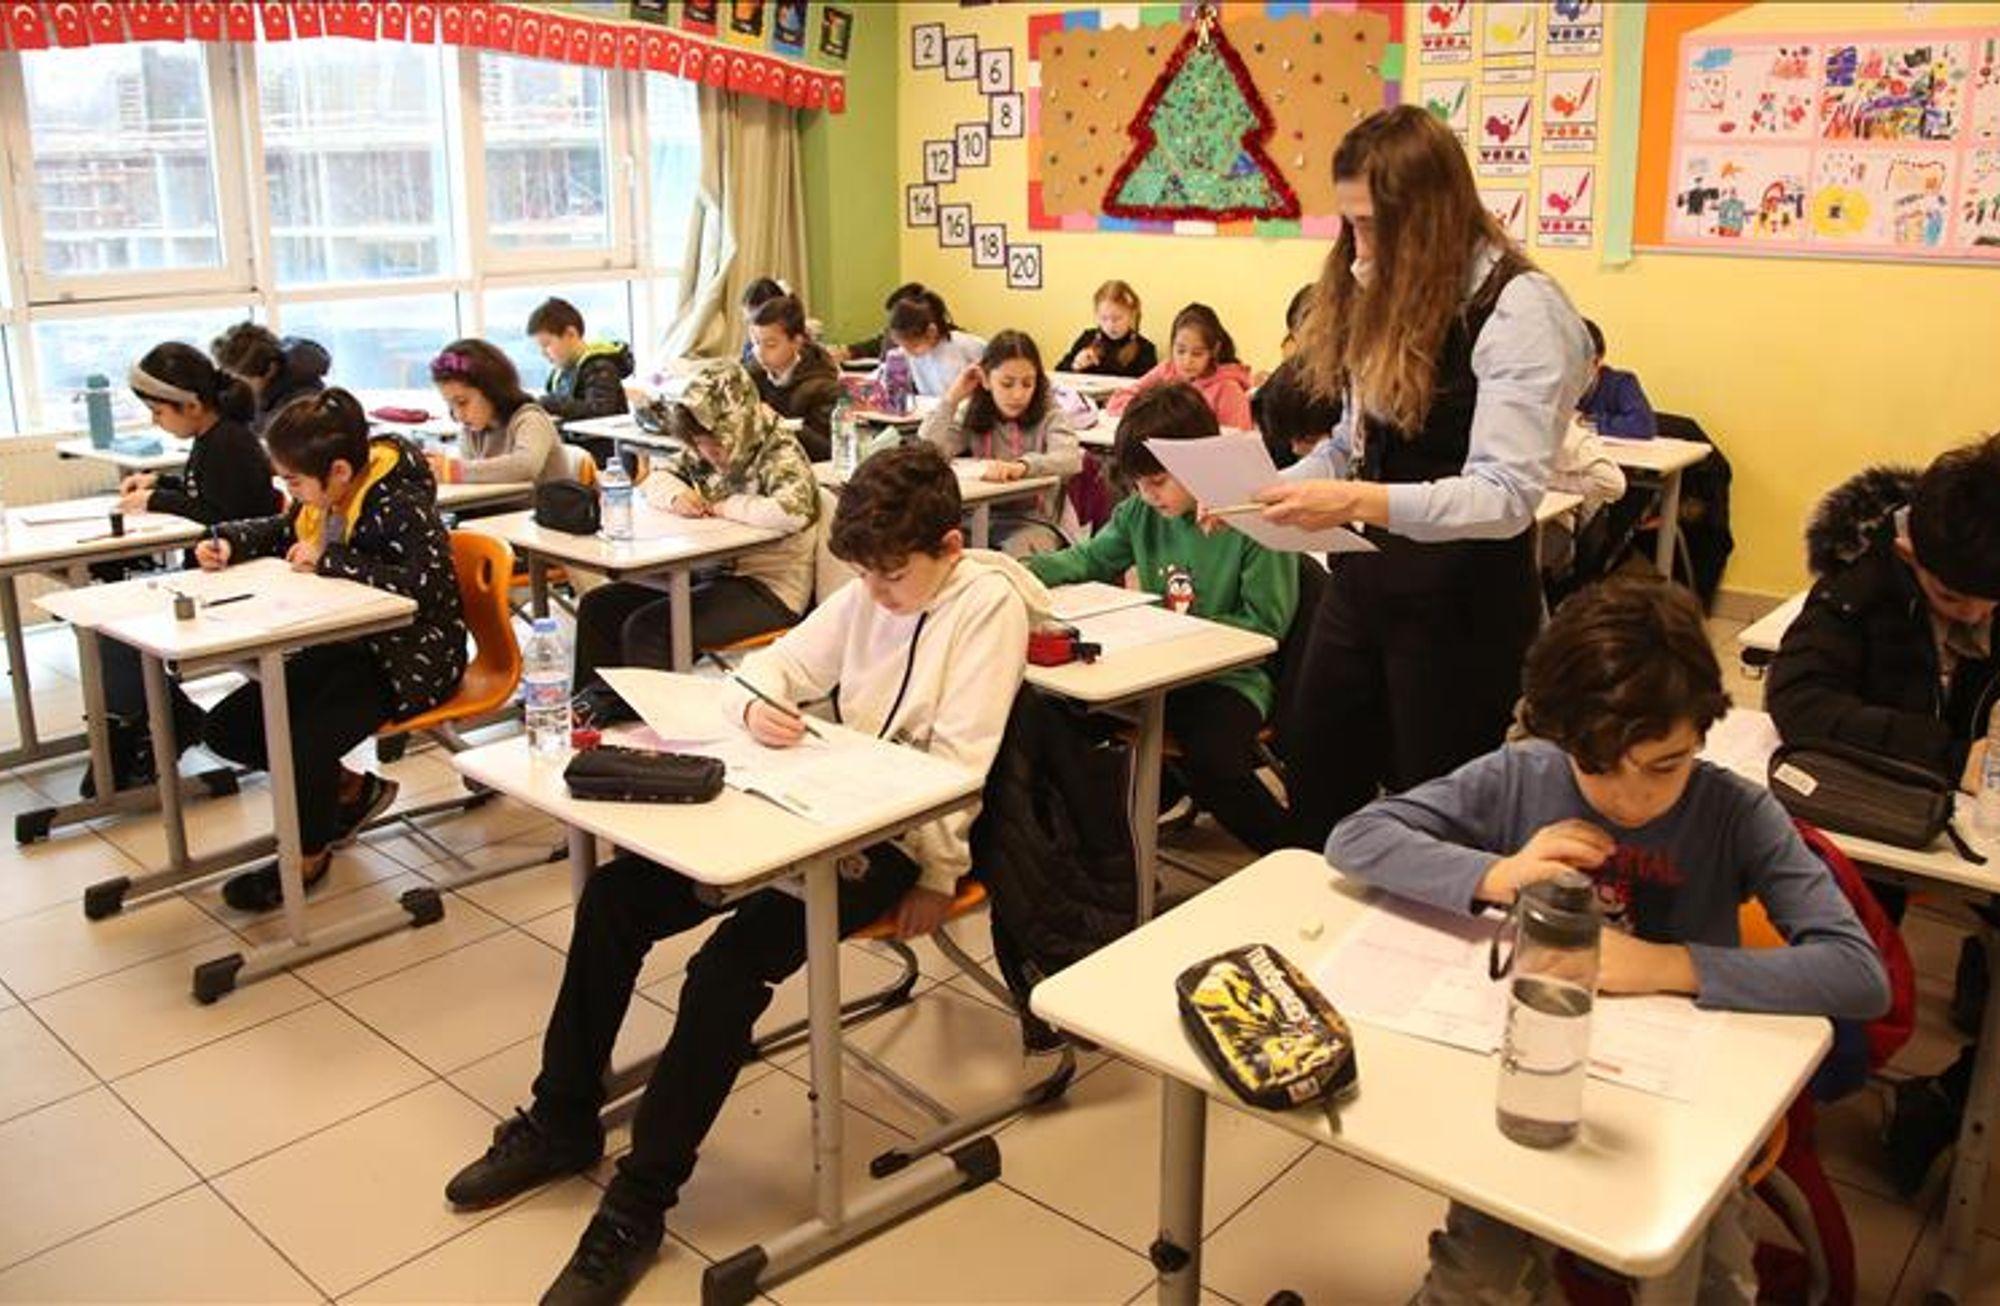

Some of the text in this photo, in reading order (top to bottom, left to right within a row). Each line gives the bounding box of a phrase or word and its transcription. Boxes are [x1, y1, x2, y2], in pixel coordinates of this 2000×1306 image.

[923, 34, 933, 59] 2
[954, 45, 967, 69] 4
[989, 60, 1002, 84] 6
[1000, 103, 1012, 128] 8
[963, 132, 983, 157] 10
[930, 150, 949, 175] 12
[912, 194, 932, 216] 14
[946, 214, 965, 238] 16
[979, 233, 1000, 258] 18
[1012, 254, 1036, 279] 20
